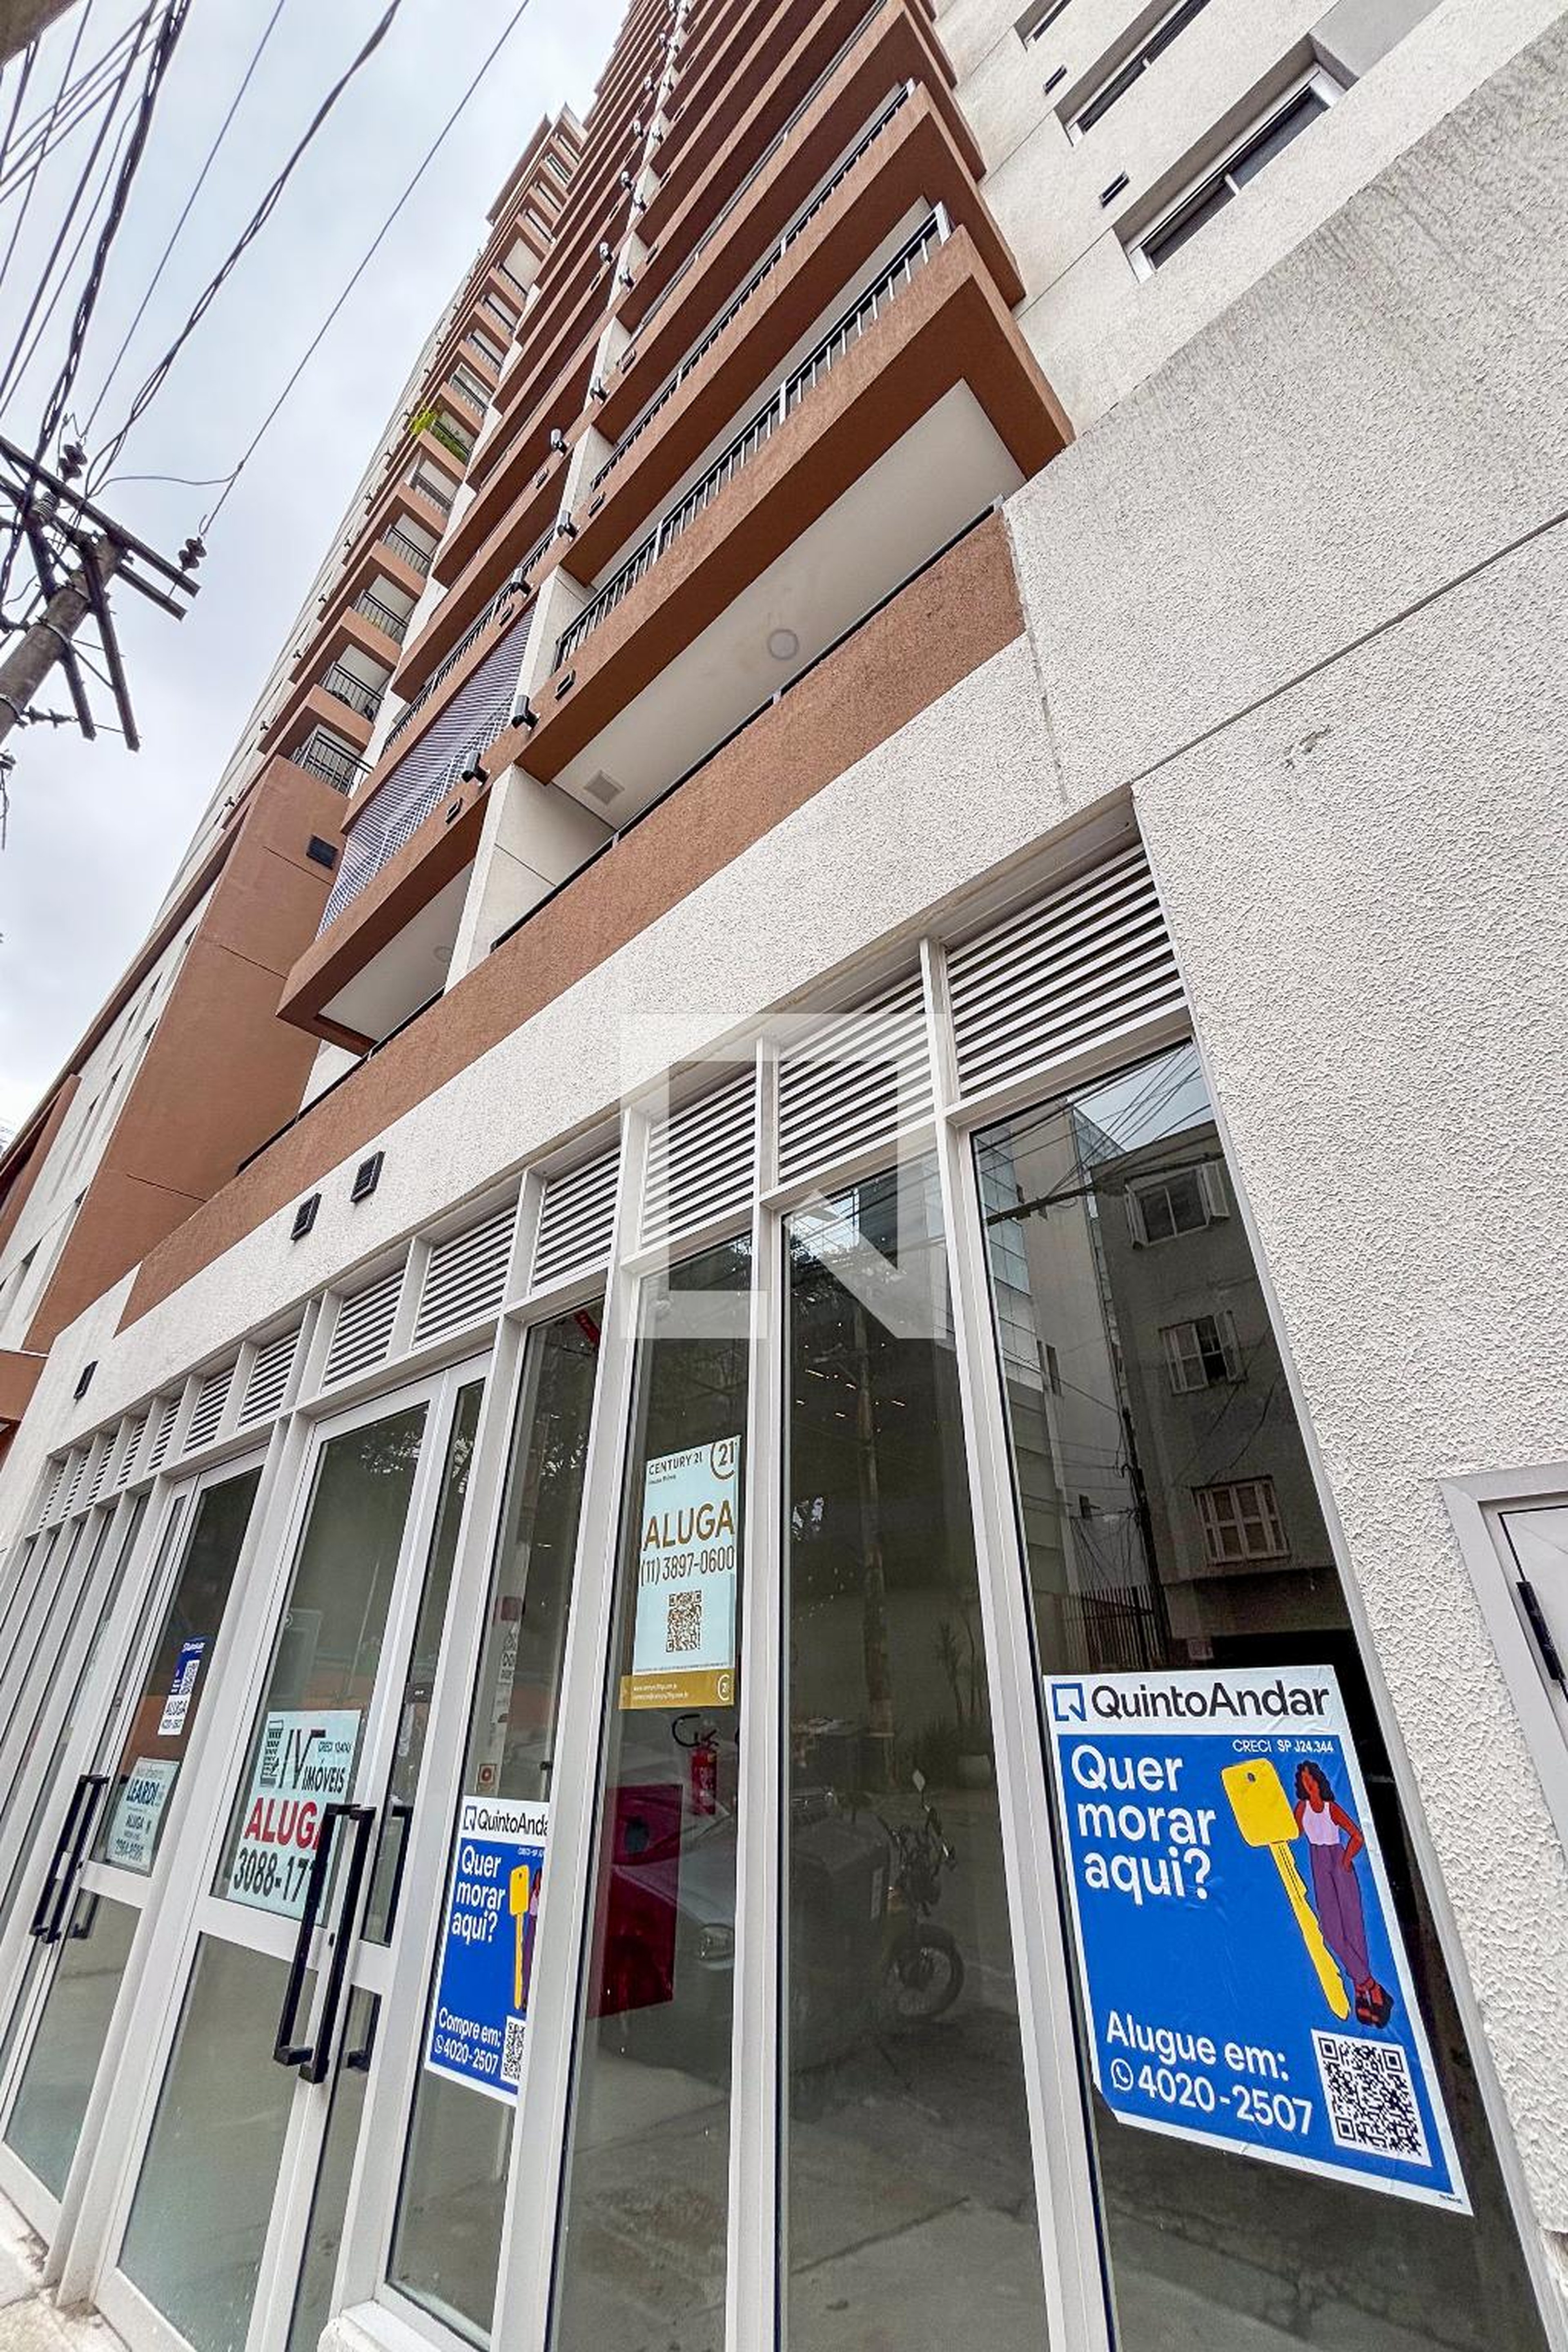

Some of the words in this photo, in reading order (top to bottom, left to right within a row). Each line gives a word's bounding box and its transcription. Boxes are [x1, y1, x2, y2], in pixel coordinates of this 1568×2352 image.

[648, 1455, 691, 1474] CENTURY
[694, 1452, 702, 1463] 21
[643, 1500, 734, 1551] ALUGA
[641, 1557, 660, 1586] (11)
[662, 1545, 734, 1580] 3897-0600
[1091, 1680, 1330, 1719] QuintoAndar
[1232, 1740, 1272, 1753] CRECI
[1278, 1740, 1292, 1753] SP
[301, 1759, 345, 1795] IMÓVEIS
[1071, 1744, 1183, 1792] Quer
[245, 1797, 321, 1851] ALUG
[1077, 1802, 1216, 1845] morar
[234, 1847, 316, 1902] 3088-17
[461, 1845, 501, 1878] Quer
[1083, 1846, 1211, 1906] aqui?
[456, 1881, 506, 1911] morar
[452, 1909, 497, 1945] aqui?
[439, 2007, 480, 2040] Compre
[482, 2026, 501, 2048] em:
[1106, 2010, 1216, 2065] Alugue
[1224, 2042, 1289, 2081] em:
[444, 2038, 499, 2075] 4020-2507
[1138, 2065, 1313, 2135] 4020-2507
